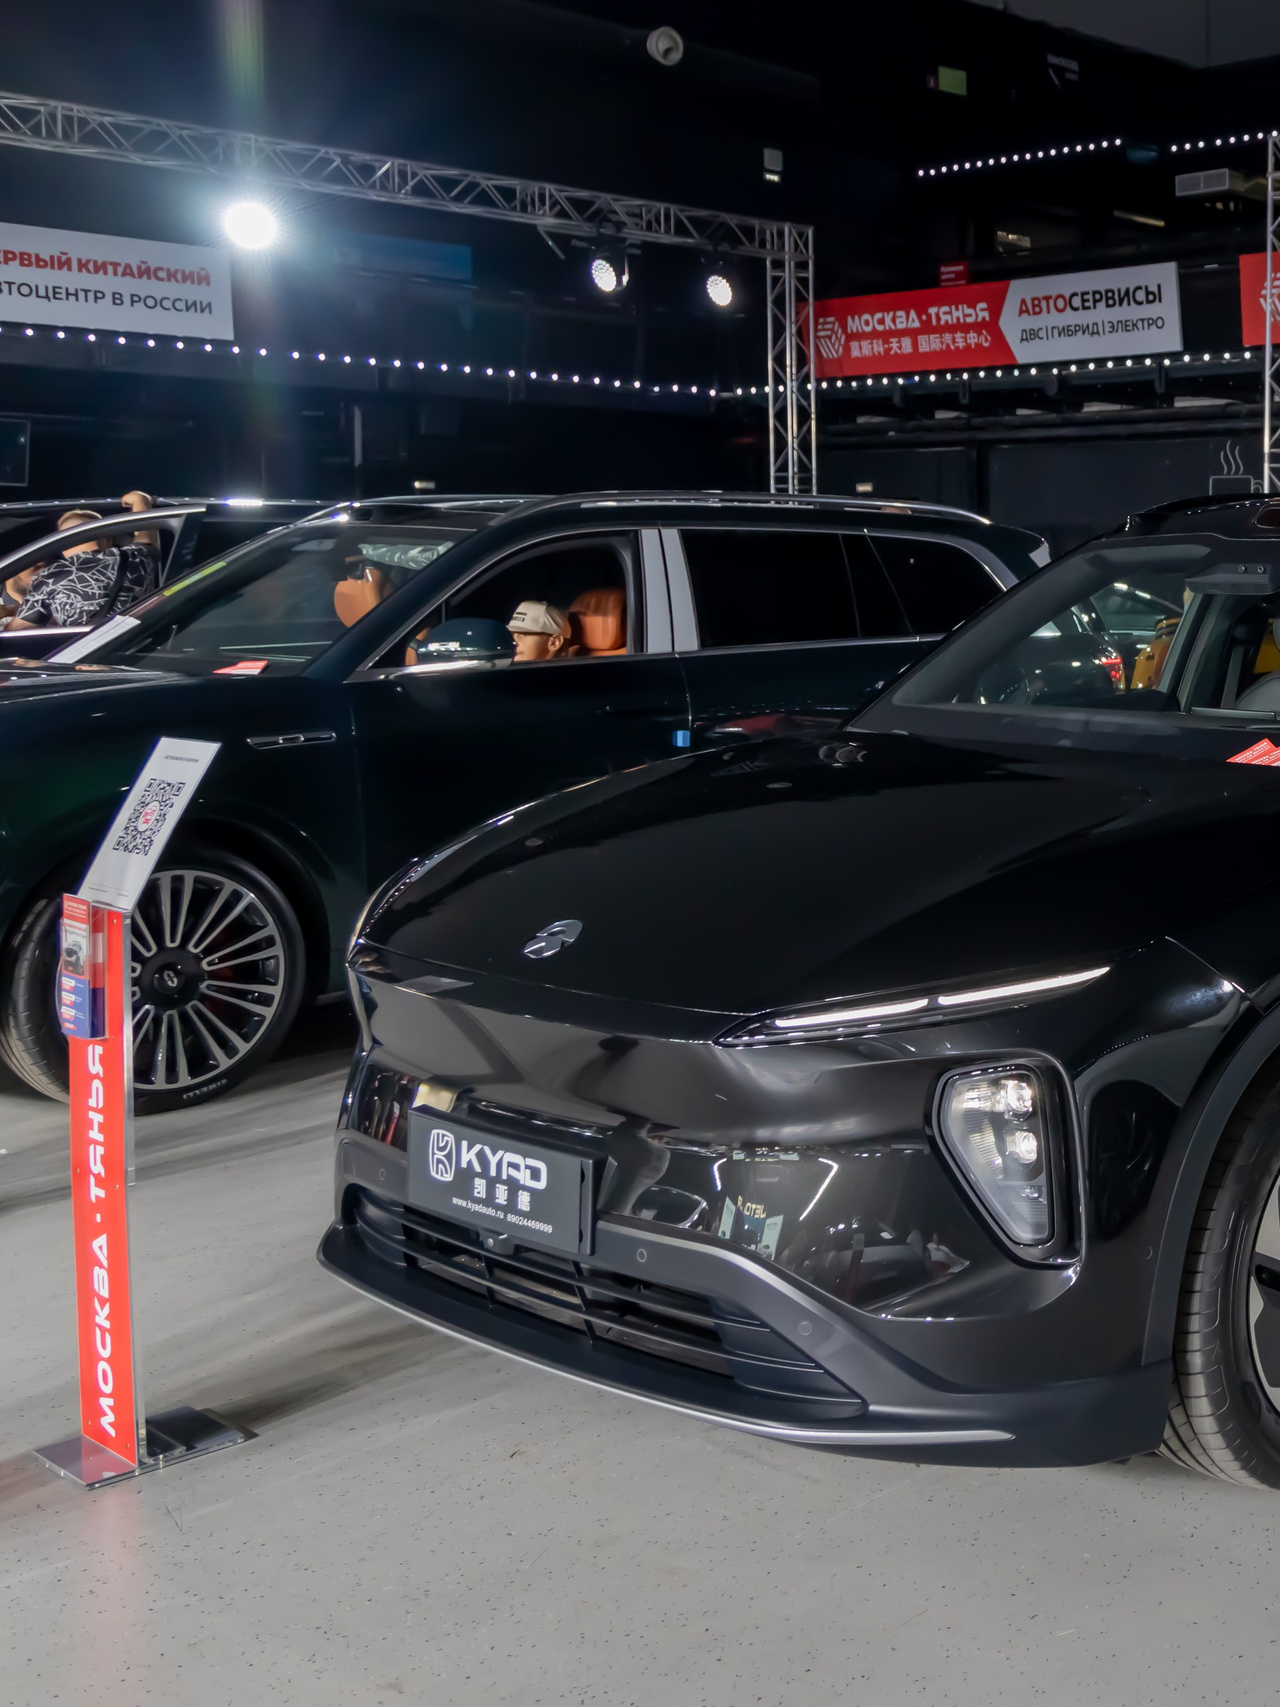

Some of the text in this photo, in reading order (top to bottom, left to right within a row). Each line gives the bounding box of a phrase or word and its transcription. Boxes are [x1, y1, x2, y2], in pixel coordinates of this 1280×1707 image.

[0, 249, 211, 287] РВЫЙ КИТАЙСКИЙ
[112, 291, 125, 306] В
[130, 294, 213, 315] РОССИИ
[1018, 283, 1162, 317] АВТОСЕРВИСЫ
[847, 302, 990, 334] МОСКВА ТЯНЬЯ
[1020, 316, 1165, 344] ДВС ГИБРИД ЭЛЕКТРО
[461, 1140, 548, 1190] KYAD
[452, 1197, 504, 1219] www.kyadauto.ru
[474, 1177, 531, 1212] 凯亚德
[87, 1044, 116, 1438] МОСКВА ТЯНЬЯ
